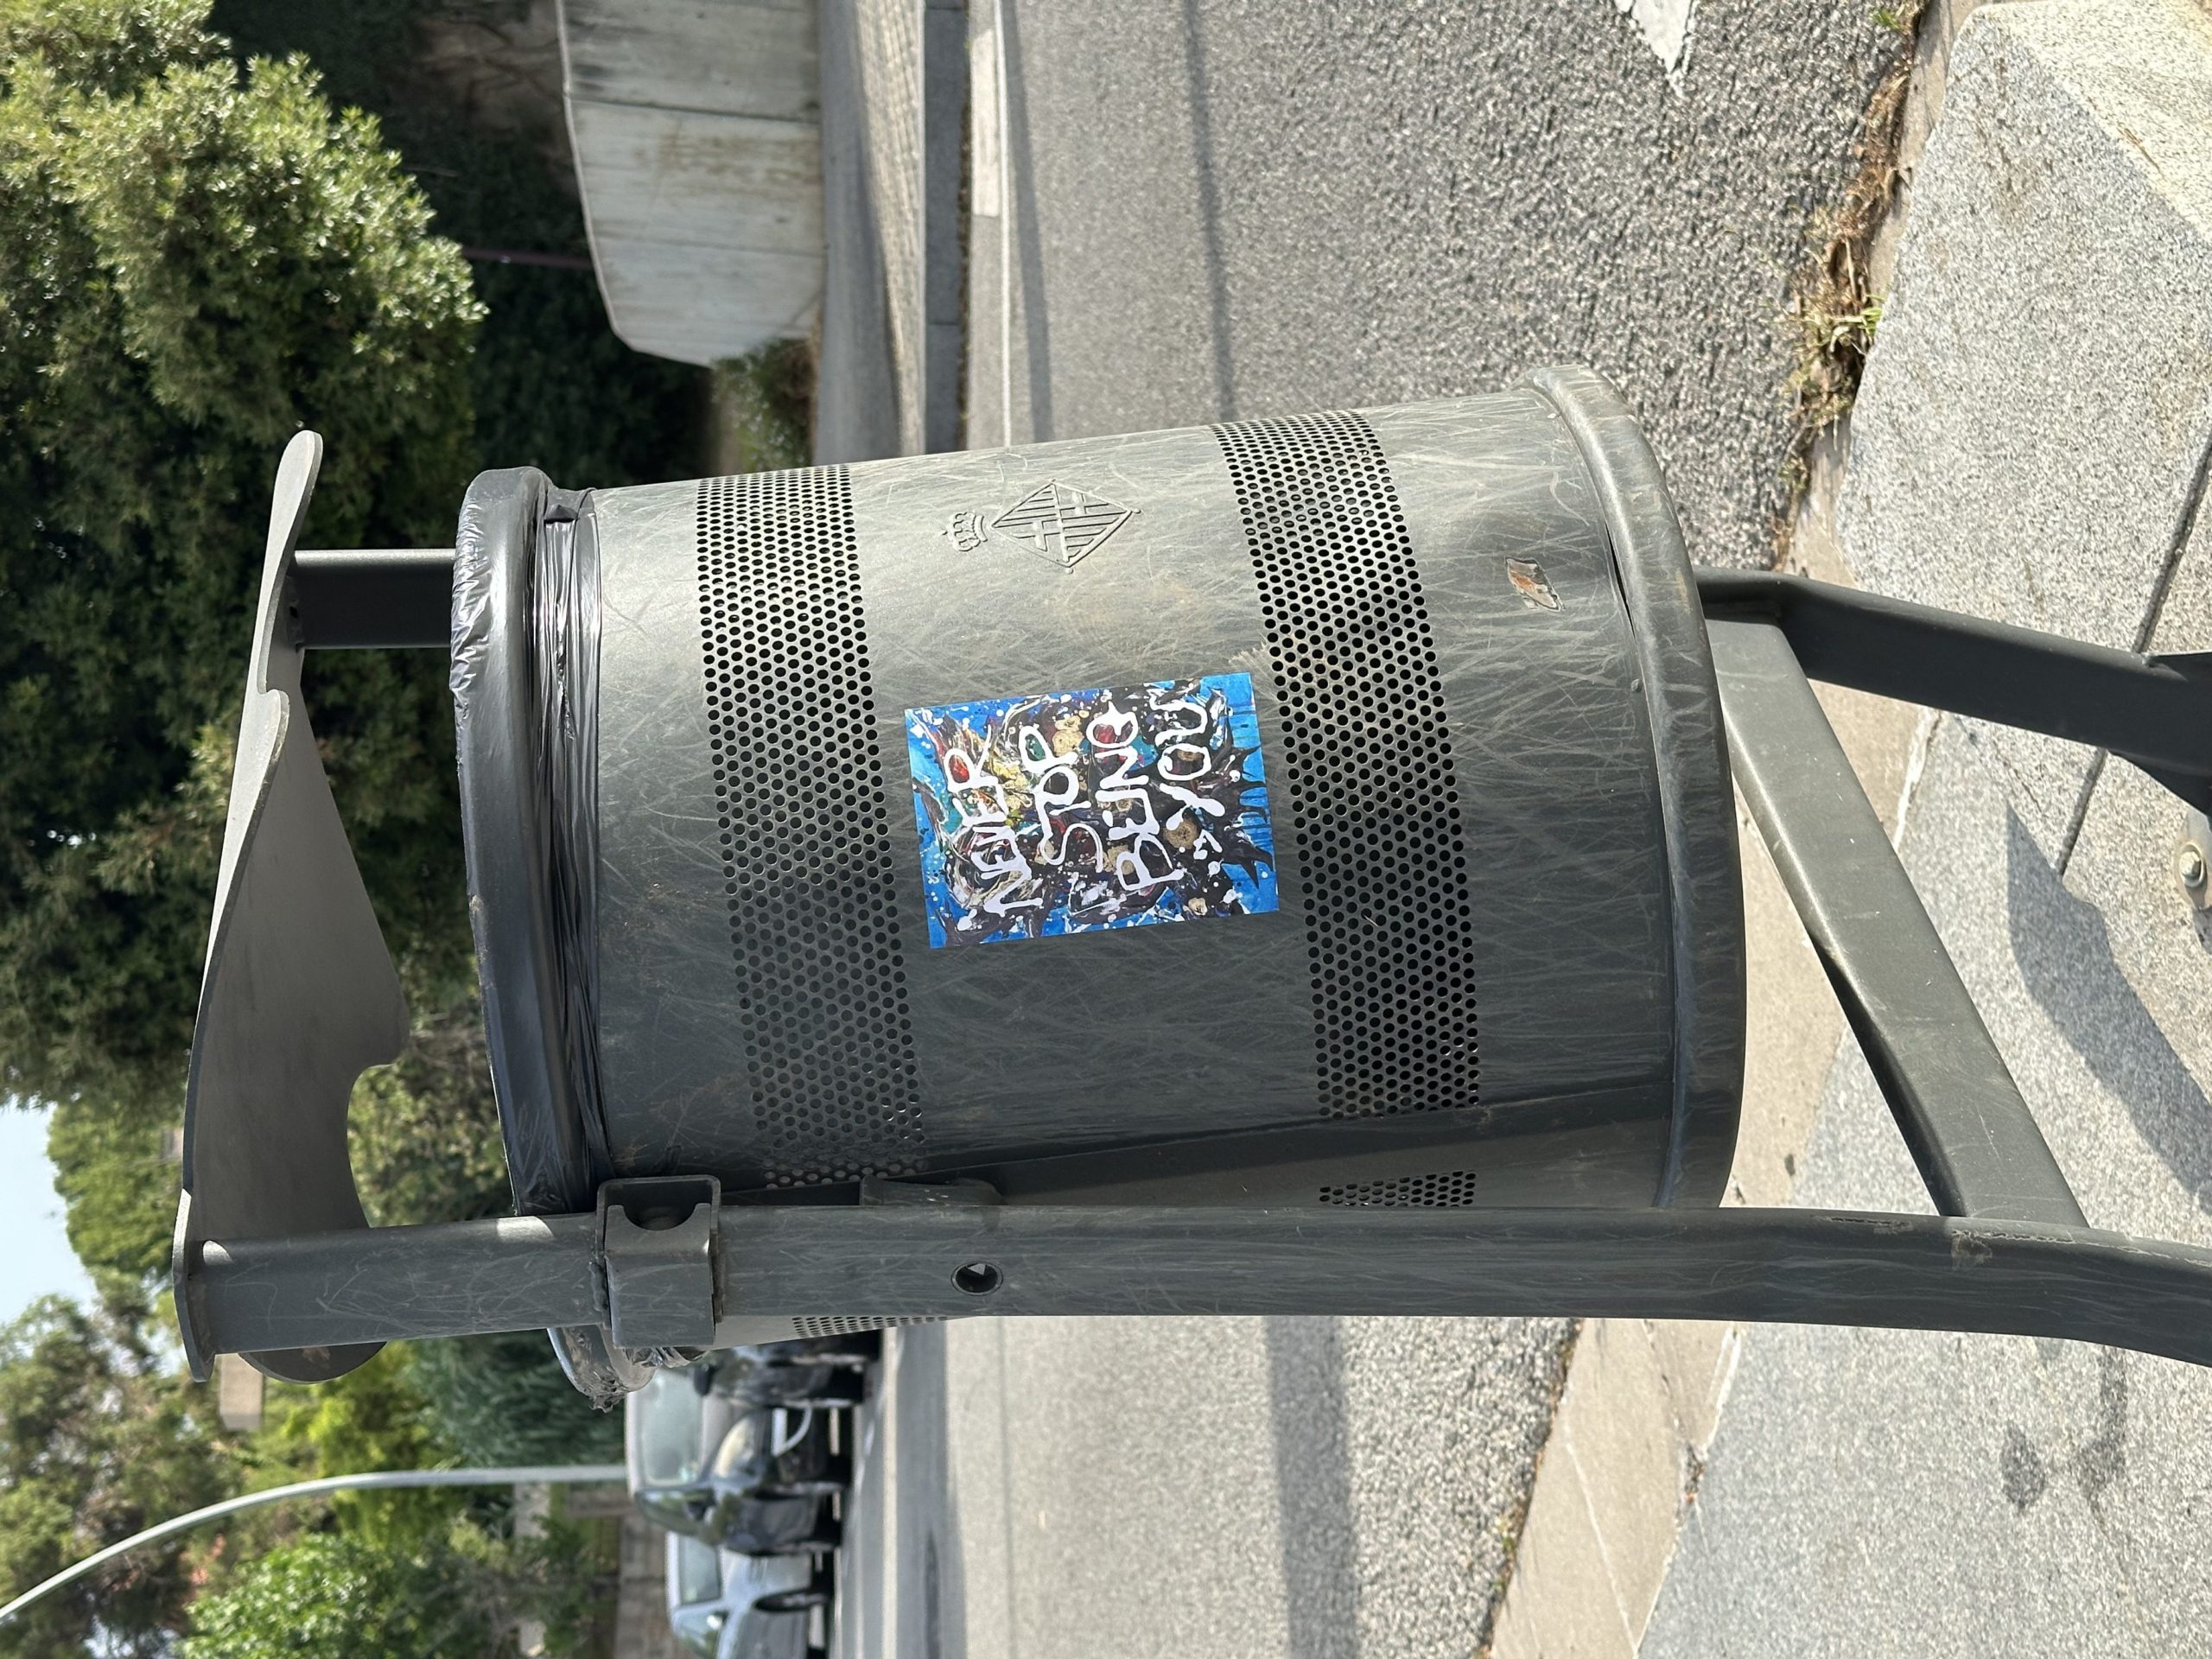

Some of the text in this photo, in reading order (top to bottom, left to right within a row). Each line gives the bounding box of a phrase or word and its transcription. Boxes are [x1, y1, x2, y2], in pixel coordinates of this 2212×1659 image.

[944, 725, 1044, 917] NEVER
[1019, 726, 1103, 874] STOP
[1086, 702, 1185, 891] BEING
[1154, 695, 1225, 831] YOU
